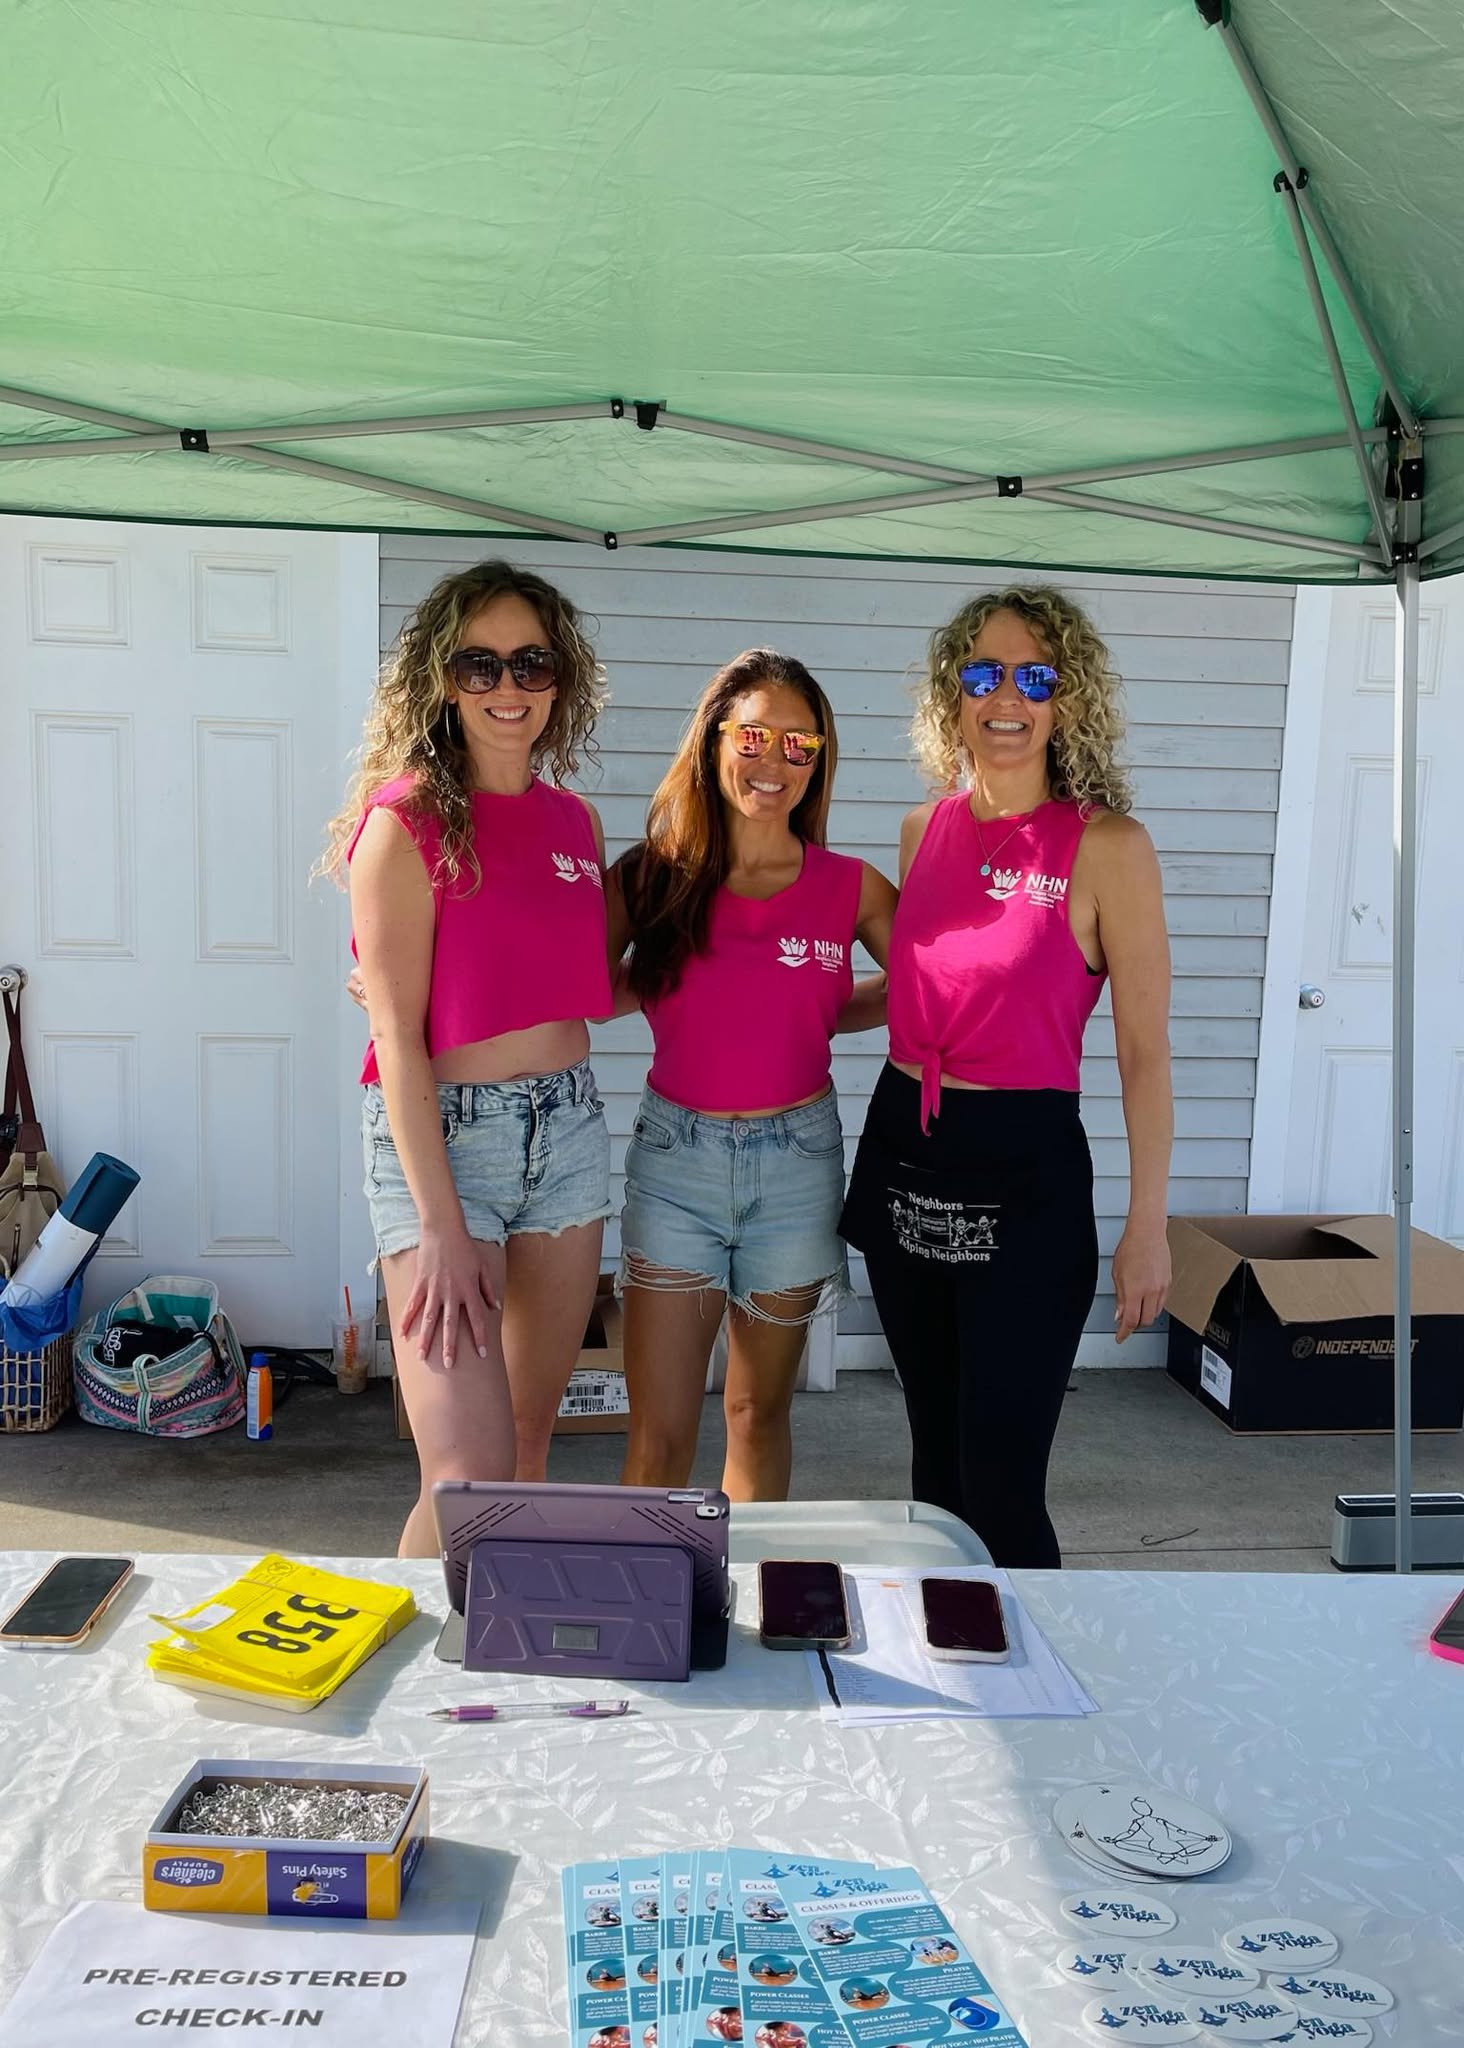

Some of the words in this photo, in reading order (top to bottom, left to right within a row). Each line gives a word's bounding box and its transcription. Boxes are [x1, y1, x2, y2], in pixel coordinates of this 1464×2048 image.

[1025, 873, 1068, 893] NHN
[814, 940, 843, 960] NHN
[908, 1191, 964, 1211] Neighbors
[931, 1248, 991, 1263] Neighbors
[1315, 1339, 1419, 1354] INDEPENDET
[236, 1594, 360, 1653] 358
[282, 1865, 307, 1877] Pins
[309, 1864, 348, 1879] Safety
[833, 1877, 867, 1888] zen
[846, 1881, 889, 1895] yoga
[801, 1903, 847, 1913] CLASSES
[859, 1894, 921, 1908] OFFERINGS
[1098, 1902, 1135, 1912] zen
[1112, 1910, 1161, 1923] yoga
[1256, 1931, 1295, 1942] zen
[1275, 1935, 1322, 1950] yoga
[1176, 1959, 1216, 1968] zen
[82, 1968, 408, 1988] PRE-REGISTERED
[1193, 1967, 1245, 1980] yoga
[1307, 1979, 1348, 1991] zen
[1323, 1989, 1377, 2003] yoga
[1120, 2004, 1159, 2016] zen
[1215, 2000, 1253, 2014] zen
[1233, 2004, 1283, 2023] yoga
[135, 2008, 325, 2028] CHECK-IN
[1136, 2010, 1188, 2027] yoga
[1297, 2017, 1325, 2028] en
[1302, 2022, 1357, 2040] yoga
